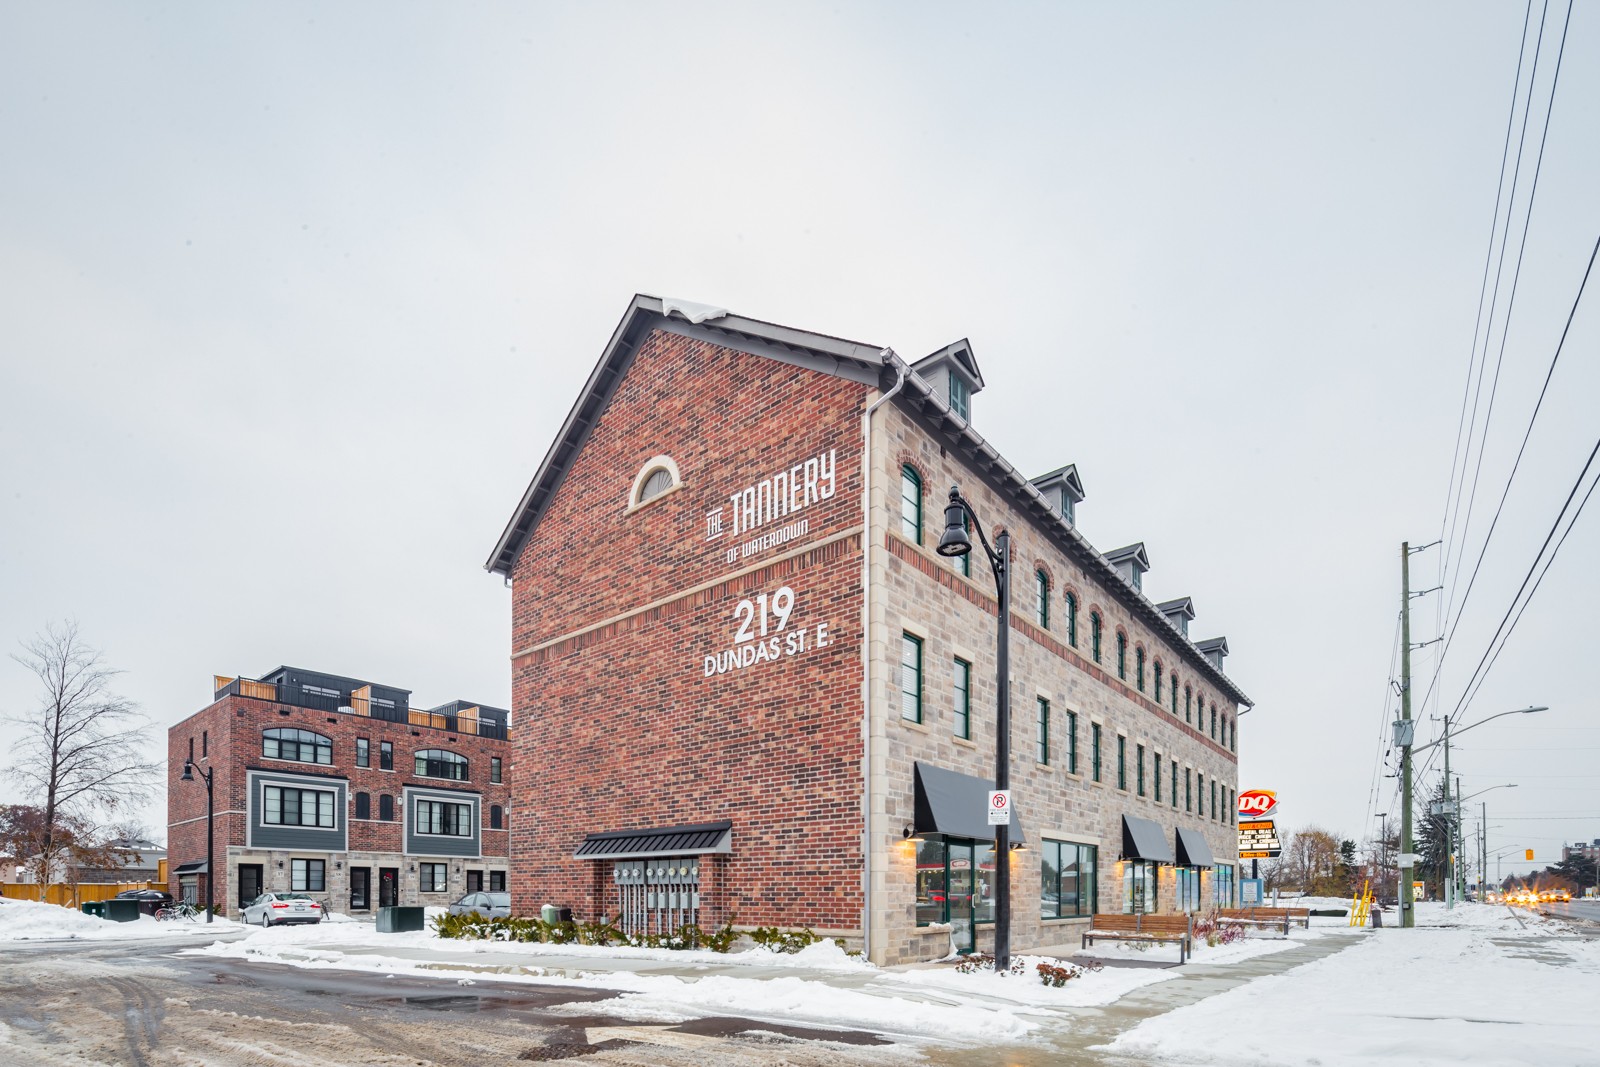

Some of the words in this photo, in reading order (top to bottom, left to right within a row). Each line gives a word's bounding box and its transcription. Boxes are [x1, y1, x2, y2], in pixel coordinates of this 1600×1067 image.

[706, 511, 723, 537] THE
[730, 449, 836, 537] TANNERY
[727, 546, 739, 564] OF
[742, 519, 809, 558] WATERDOWN
[734, 586, 795, 644] 219
[704, 636, 781, 677] DUNDAS
[786, 629, 812, 655] ST.
[817, 623, 834, 648] E.
[1238, 795, 1270, 811] DQ
